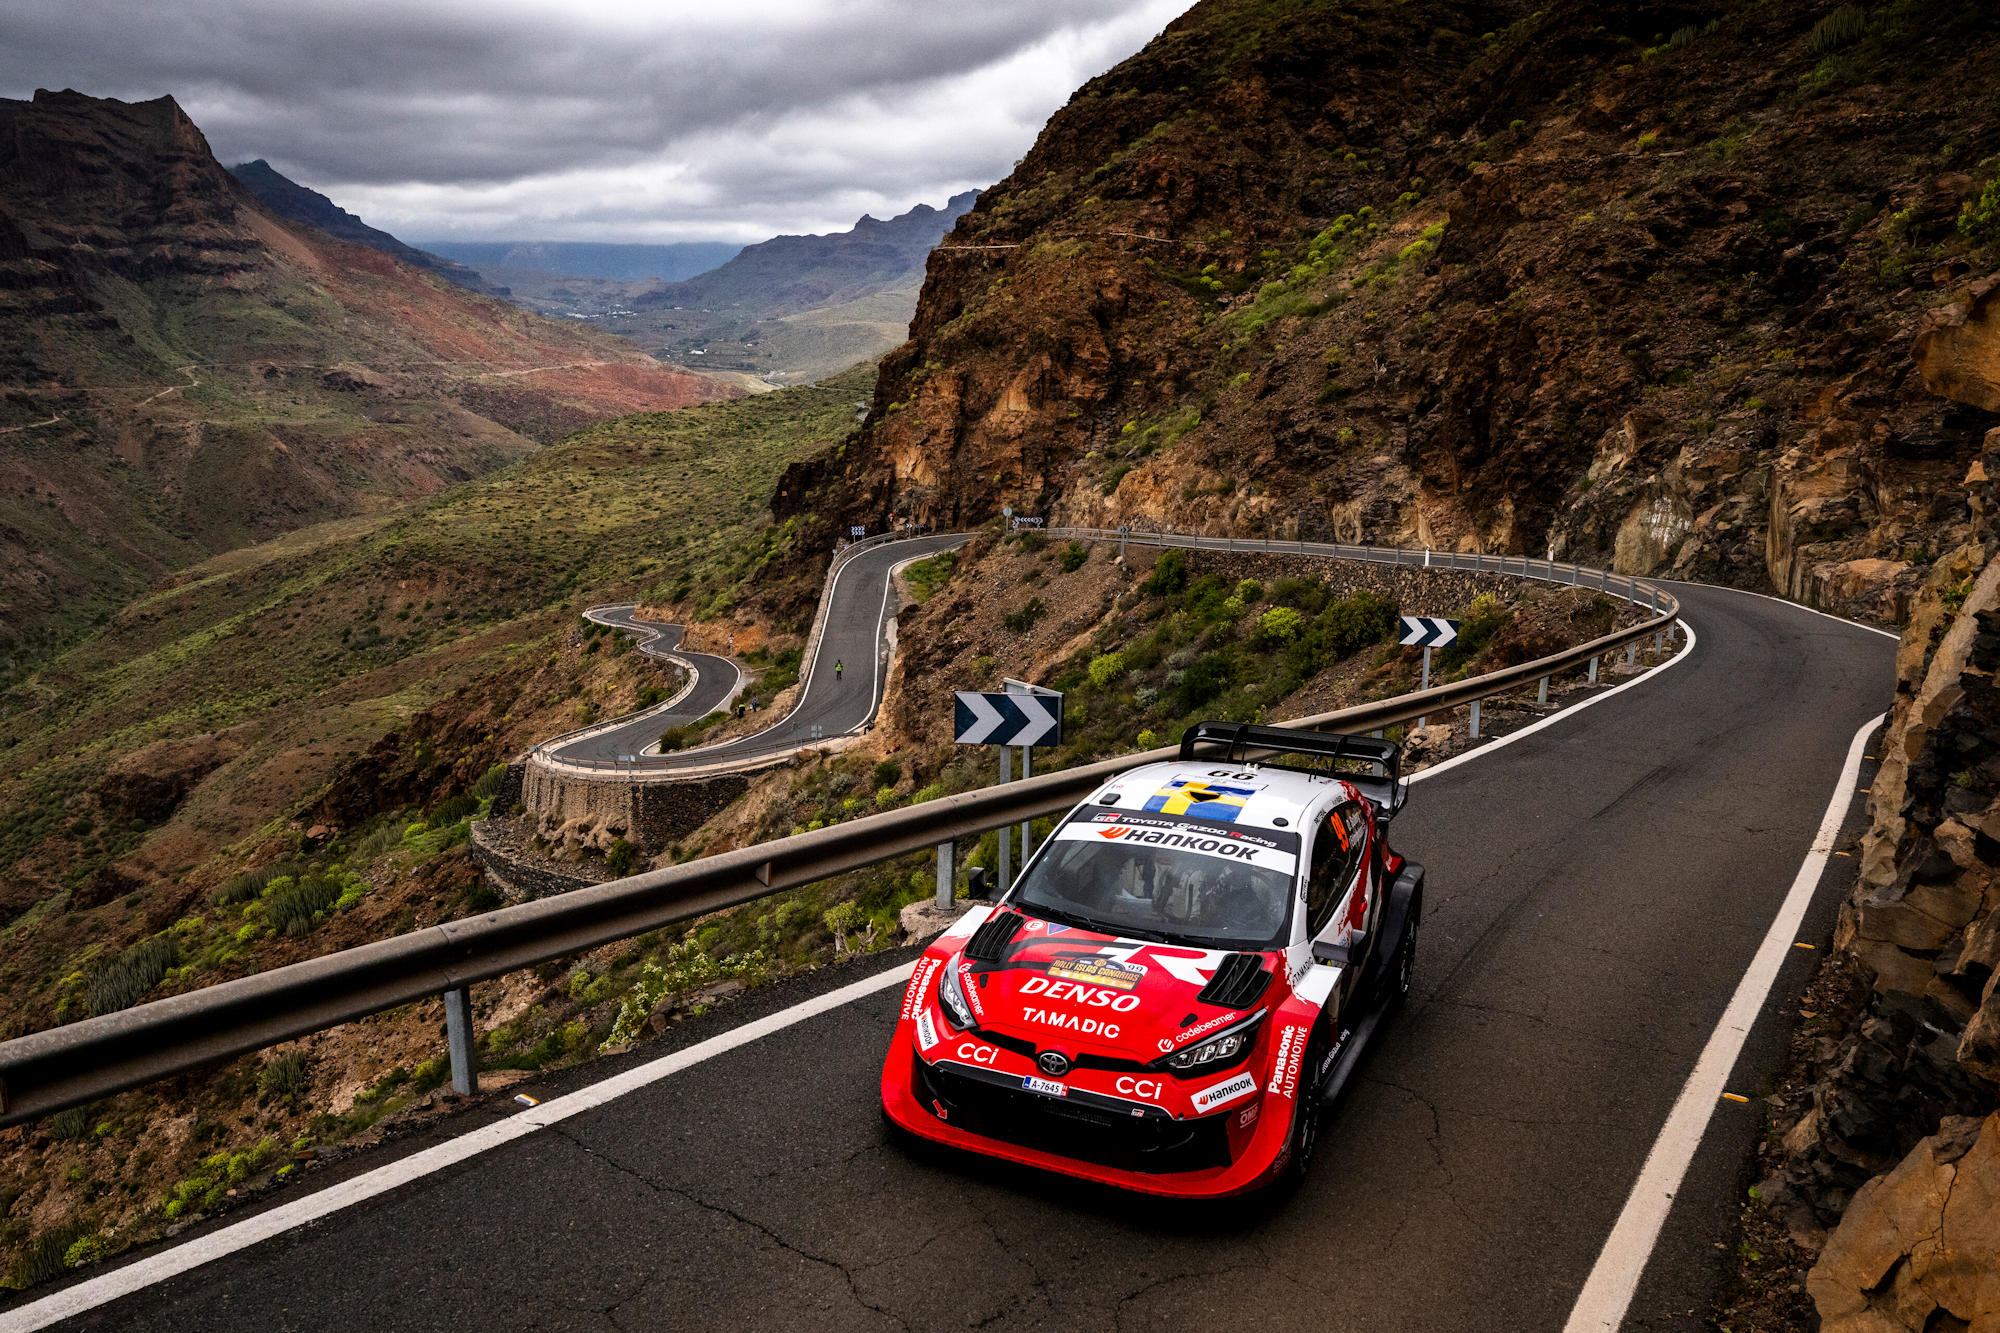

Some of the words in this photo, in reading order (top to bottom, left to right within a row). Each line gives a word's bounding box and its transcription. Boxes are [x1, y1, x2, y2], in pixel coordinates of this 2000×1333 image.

[1121, 816, 1174, 828] TOYOTA
[1229, 831, 1278, 848] Racing
[1330, 811, 1349, 852] 99
[1053, 959, 1074, 970] RALLY
[1074, 962, 1098, 975] ISLAS
[1097, 965, 1140, 983] CANARIAS
[1127, 964, 1144, 972] 99
[1294, 956, 1314, 982] TAMADIC
[901, 956, 930, 1021] AUTOMOTIVE
[911, 959, 942, 1020] Panasonic
[964, 973, 985, 1016] codebeamer
[1019, 977, 1141, 1012] DENSO
[1023, 1007, 1121, 1039] TAMADIC
[1175, 1012, 1236, 1043] codebeamer
[1267, 1025, 1296, 1095] Panasonic
[1283, 1026, 1307, 1098] AUTOMOTIVE
[1031, 1079, 1060, 1093] A-7645
[1240, 1105, 1258, 1124] OMP
